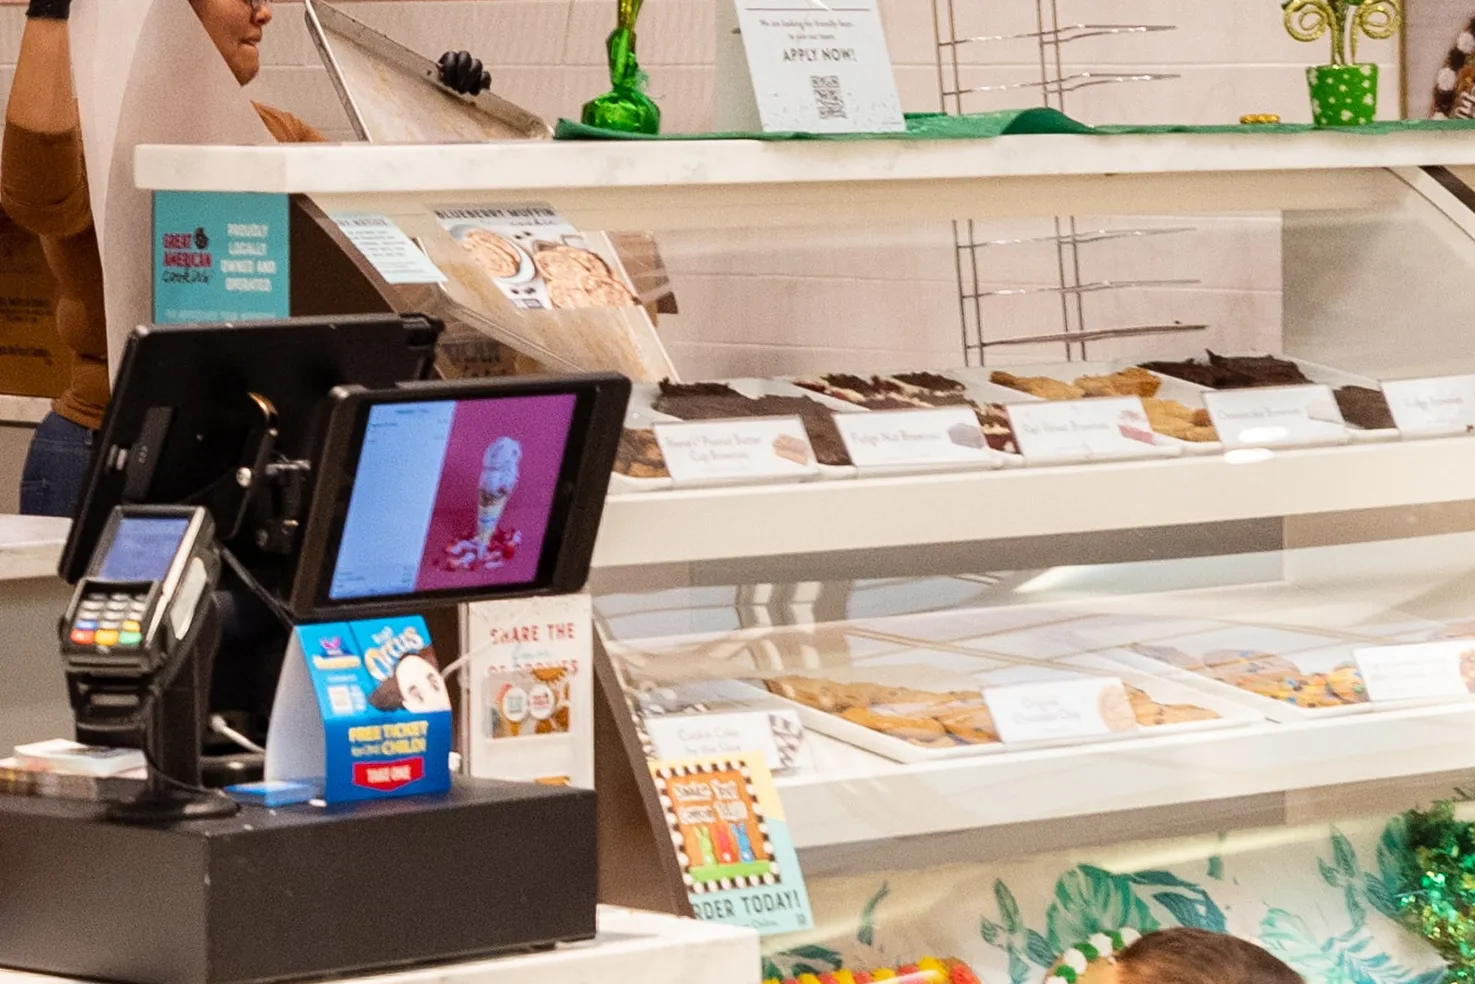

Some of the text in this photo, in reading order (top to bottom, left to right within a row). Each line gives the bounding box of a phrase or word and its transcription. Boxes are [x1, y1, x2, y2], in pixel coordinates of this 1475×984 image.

[782, 48, 858, 62] APPLY NOW!
[433, 207, 557, 220] BLUEBERRY MUFFIN
[227, 223, 269, 239] PROUDLY
[163, 233, 192, 249] GREAT
[228, 241, 267, 256] LOCALLY
[163, 252, 212, 268] AMERICAN
[220, 259, 276, 274] OWNED AND
[225, 277, 272, 292] OPERATED
[490, 622, 576, 646] SHARE THE
[348, 725, 382, 743] FREE
[389, 765, 412, 781] ONE
[692, 889, 801, 921] RDER TODAY!
